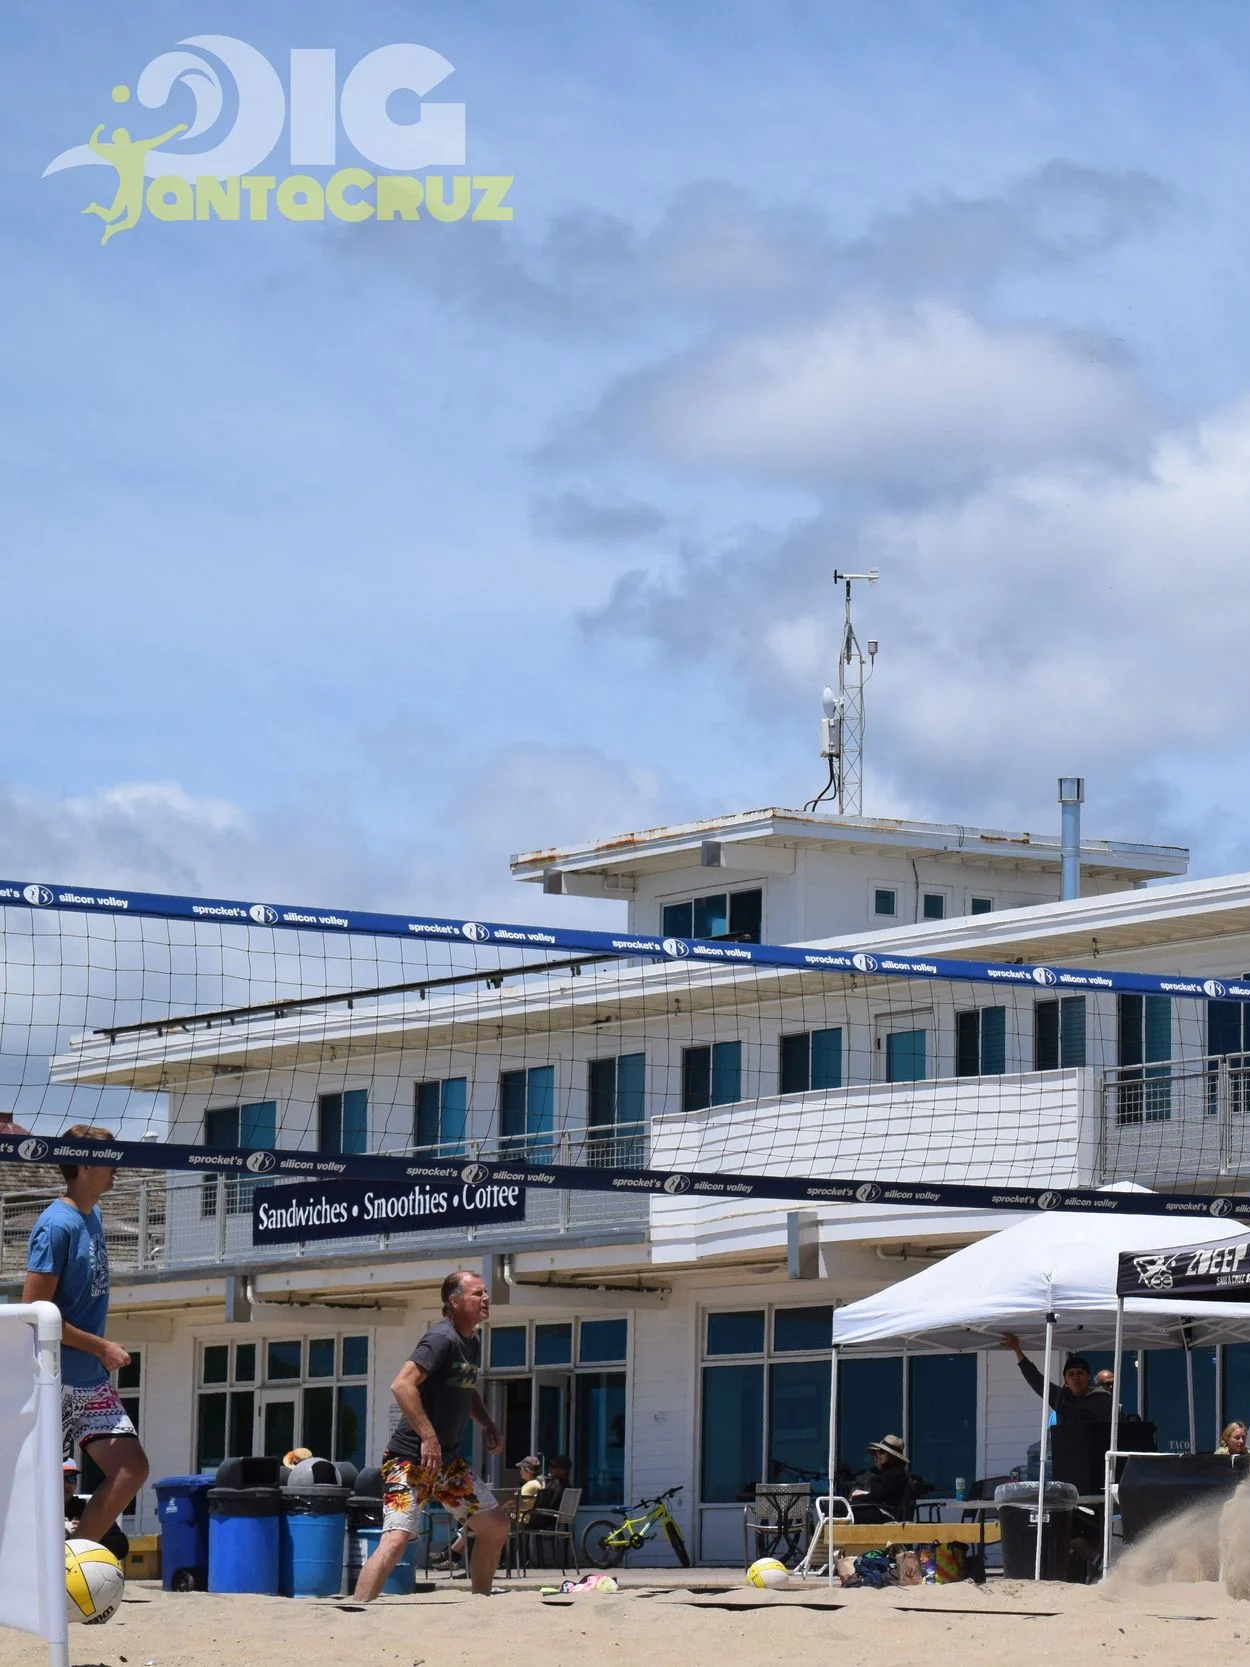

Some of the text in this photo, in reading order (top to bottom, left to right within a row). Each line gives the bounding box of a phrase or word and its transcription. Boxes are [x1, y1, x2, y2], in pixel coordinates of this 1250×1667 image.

[59, 891, 128, 909] silicon volley
[192, 903, 349, 928] sprocket's silicon volley
[408, 921, 556, 944] sprocket's silicon volley
[612, 937, 752, 960] sprocket's silicon volley
[805, 953, 937, 974] sprocket's silicon volley
[987, 968, 1113, 988] sprocket's silicon volley
[1160, 981, 1202, 993] sprocket's
[53, 1145, 124, 1162] silicon volley
[188, 1154, 347, 1173] sprocket's silicon volley
[406, 1165, 555, 1185] sprocket's silicon volley
[612, 1176, 753, 1195] sprocket's silicon volley
[806, 1186, 941, 1202] sprocket's silicon volley
[258, 1184, 519, 1231] Sandwiches Smoothies Coffee
[991, 1194, 1118, 1210] sprocket's silicon volley
[1165, 1201, 1208, 1213] sprocket's
